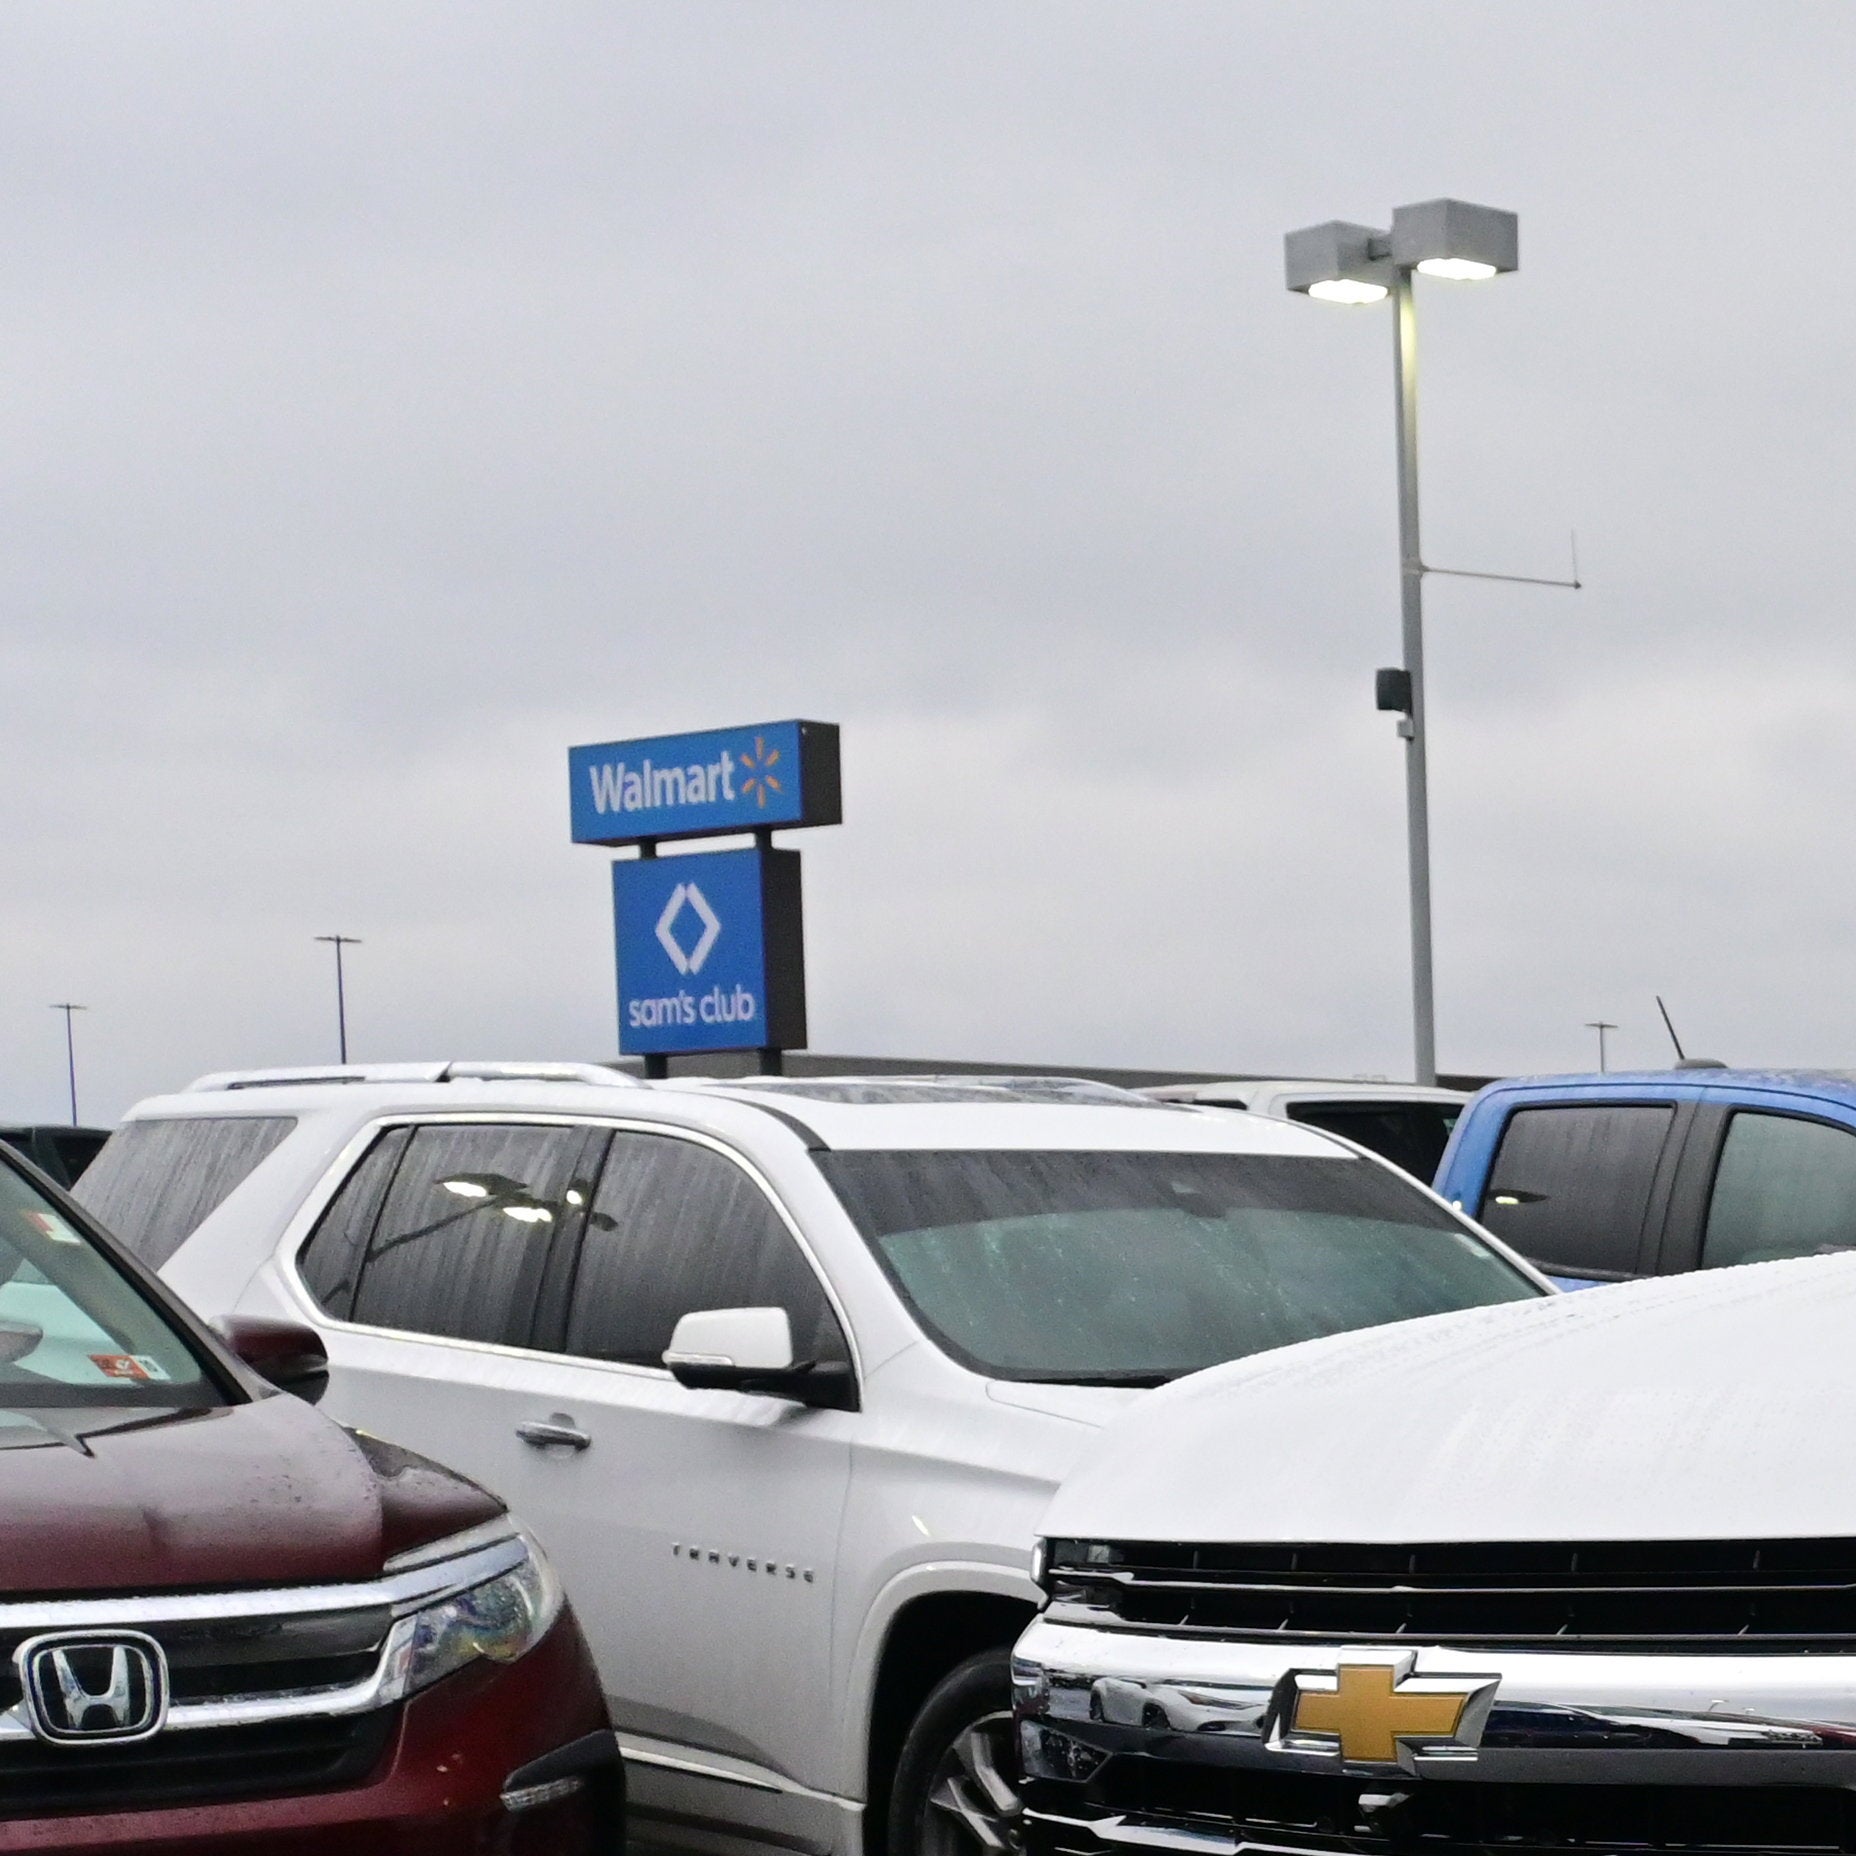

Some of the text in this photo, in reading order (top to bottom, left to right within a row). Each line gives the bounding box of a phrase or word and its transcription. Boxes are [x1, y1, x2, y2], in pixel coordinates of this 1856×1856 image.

[589, 750, 736, 815] Walmart
[699, 983, 756, 1022] club
[672, 1542, 814, 1584] TRAVERSE
